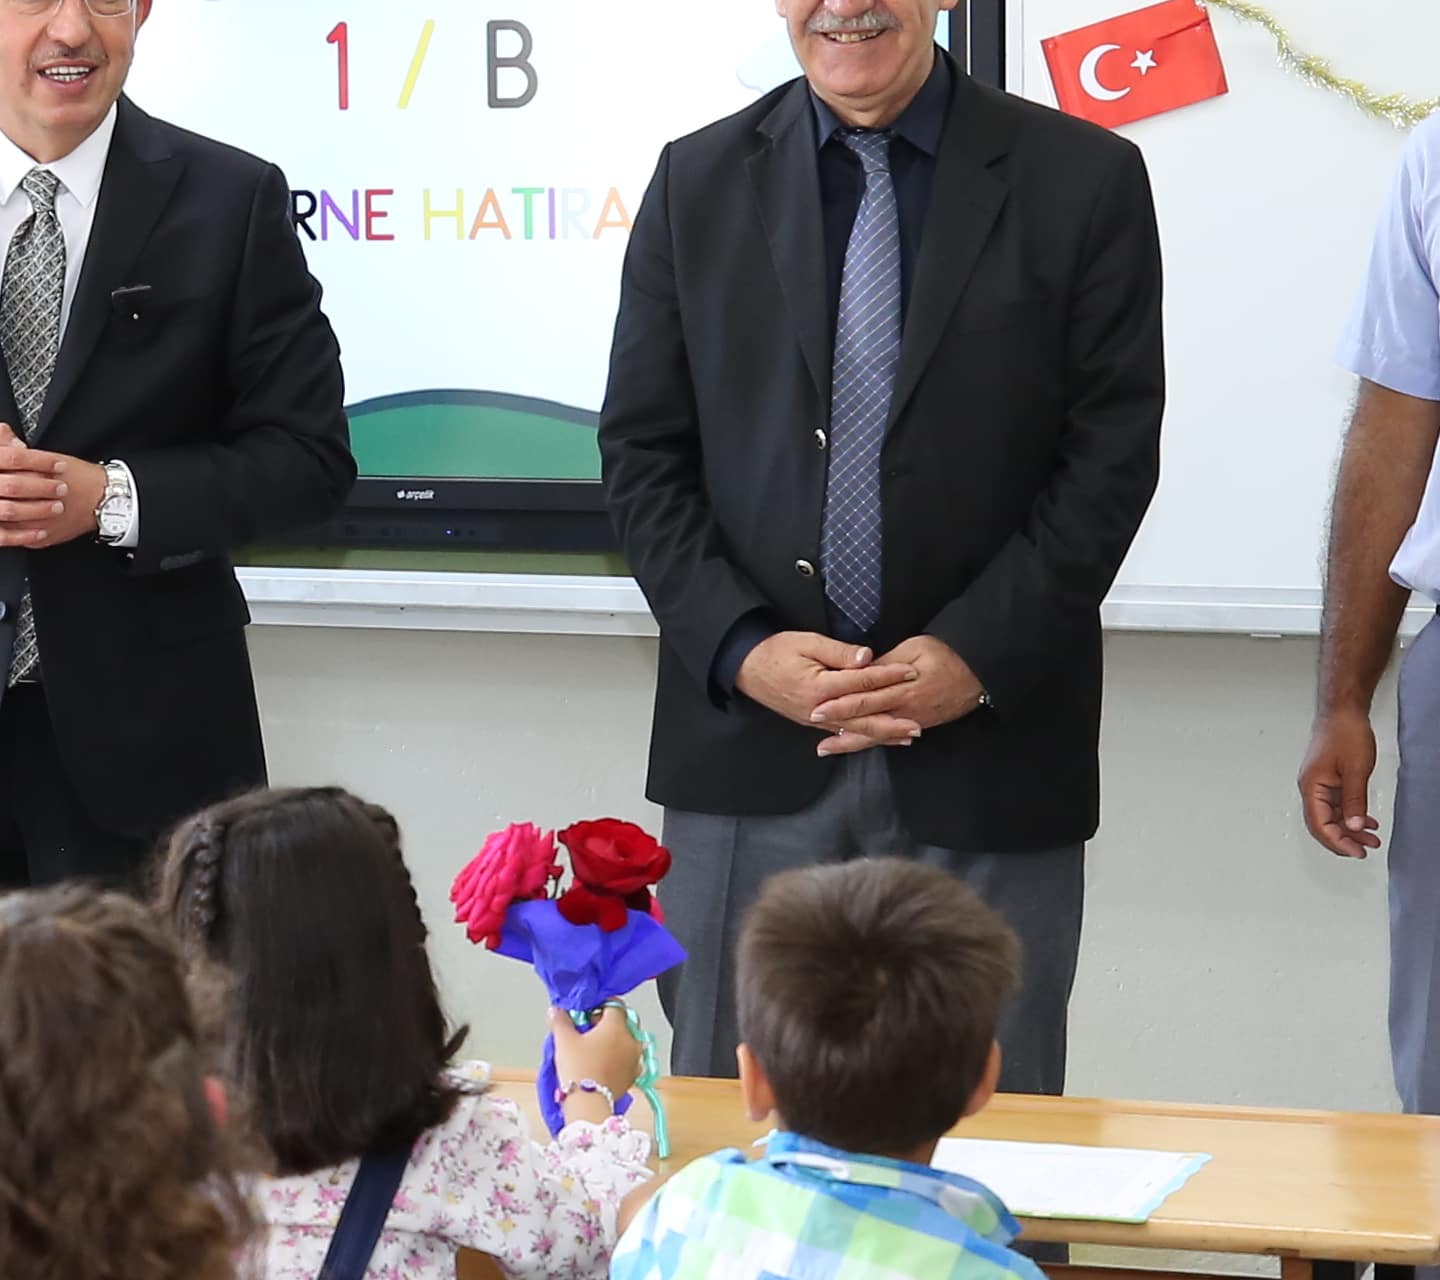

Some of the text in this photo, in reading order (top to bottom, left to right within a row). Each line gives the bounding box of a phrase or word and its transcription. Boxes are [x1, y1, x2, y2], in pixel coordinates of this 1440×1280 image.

[326, 21, 349, 110] 1
[486, 19, 538, 109] B
[290, 187, 635, 241] RNE HATIRA
